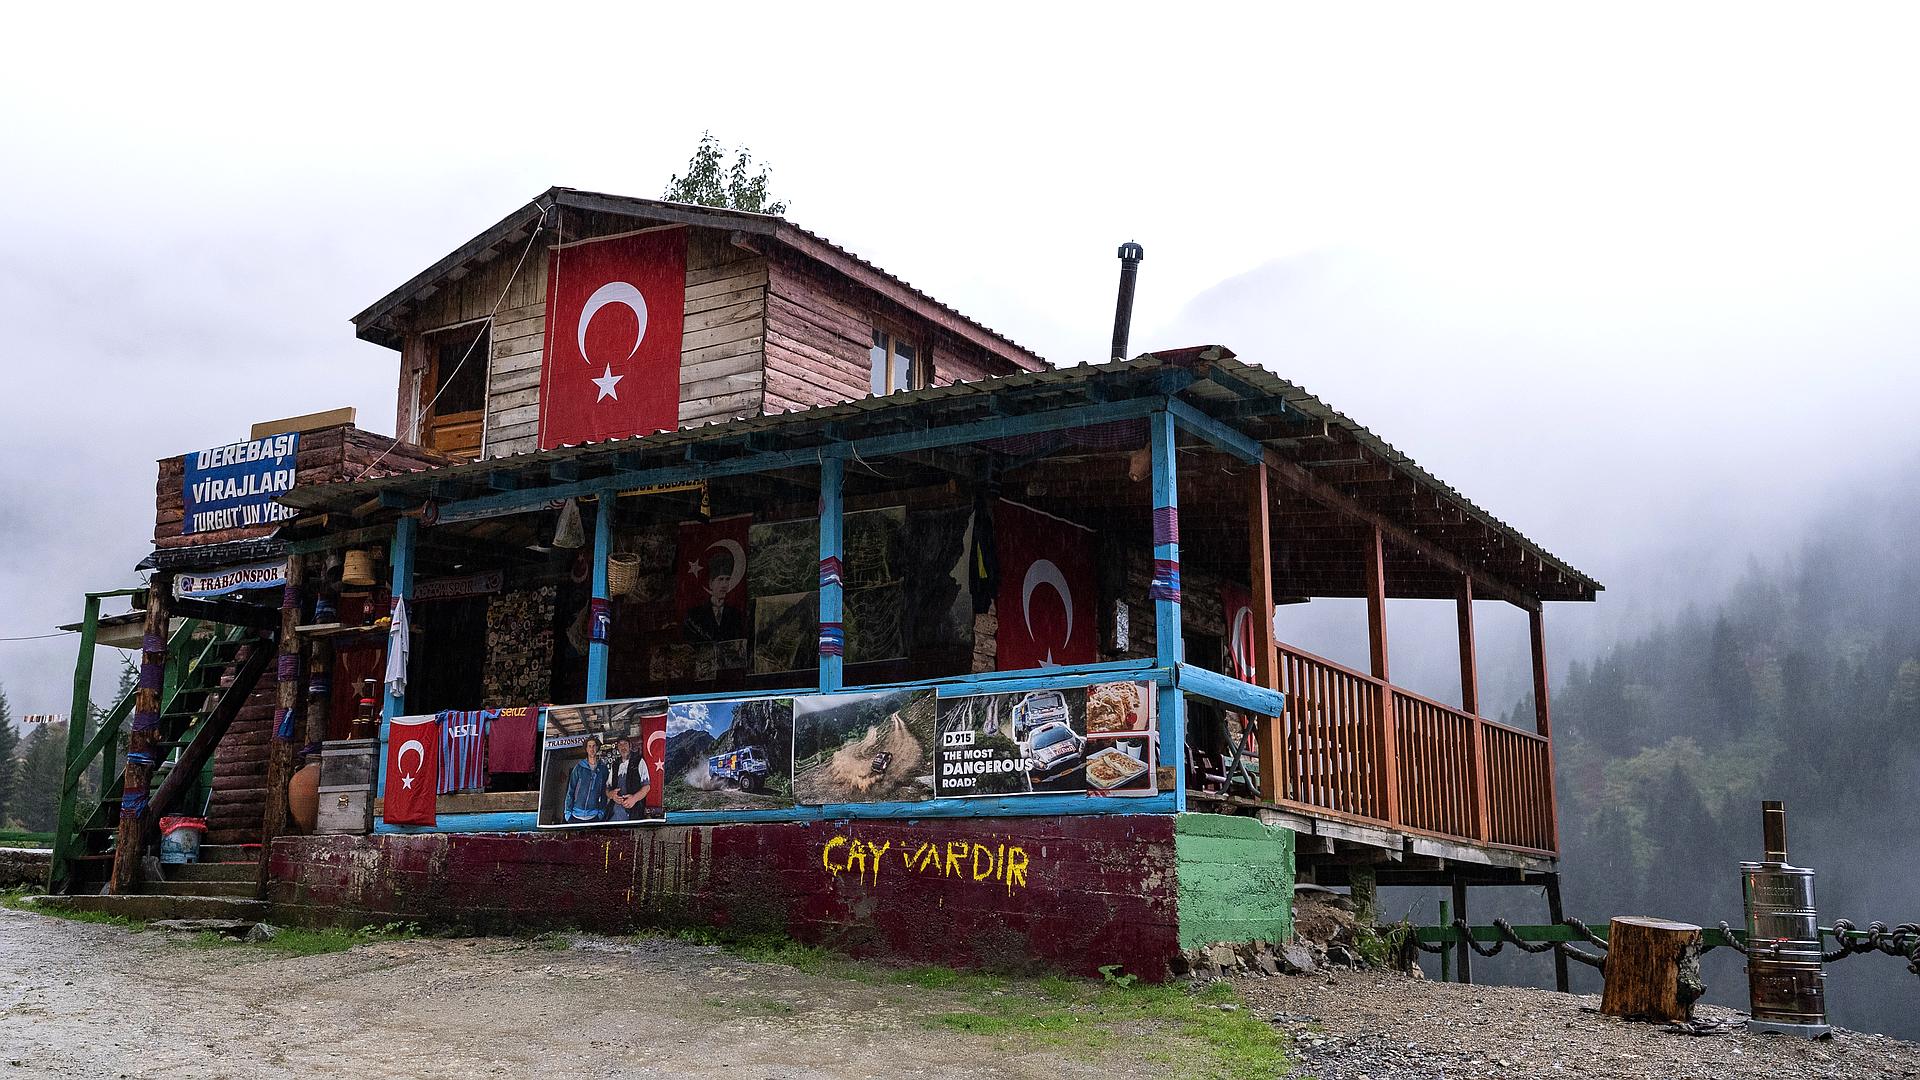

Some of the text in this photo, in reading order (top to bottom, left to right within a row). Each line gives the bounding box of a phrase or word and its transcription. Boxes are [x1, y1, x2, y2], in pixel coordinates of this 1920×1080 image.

[197, 434, 295, 470] DEREBAŞI
[192, 469, 296, 504] VİRAJLARI
[193, 504, 260, 533] TURGUT'UN
[200, 567, 279, 591] TRABZONSPOR
[945, 733, 972, 744] D 915
[943, 748, 994, 761] THE MOST
[943, 758, 1034, 776] DANGEROUS
[942, 777, 977, 788] ROAD?
[901, 840, 1030, 893] VARDIR
